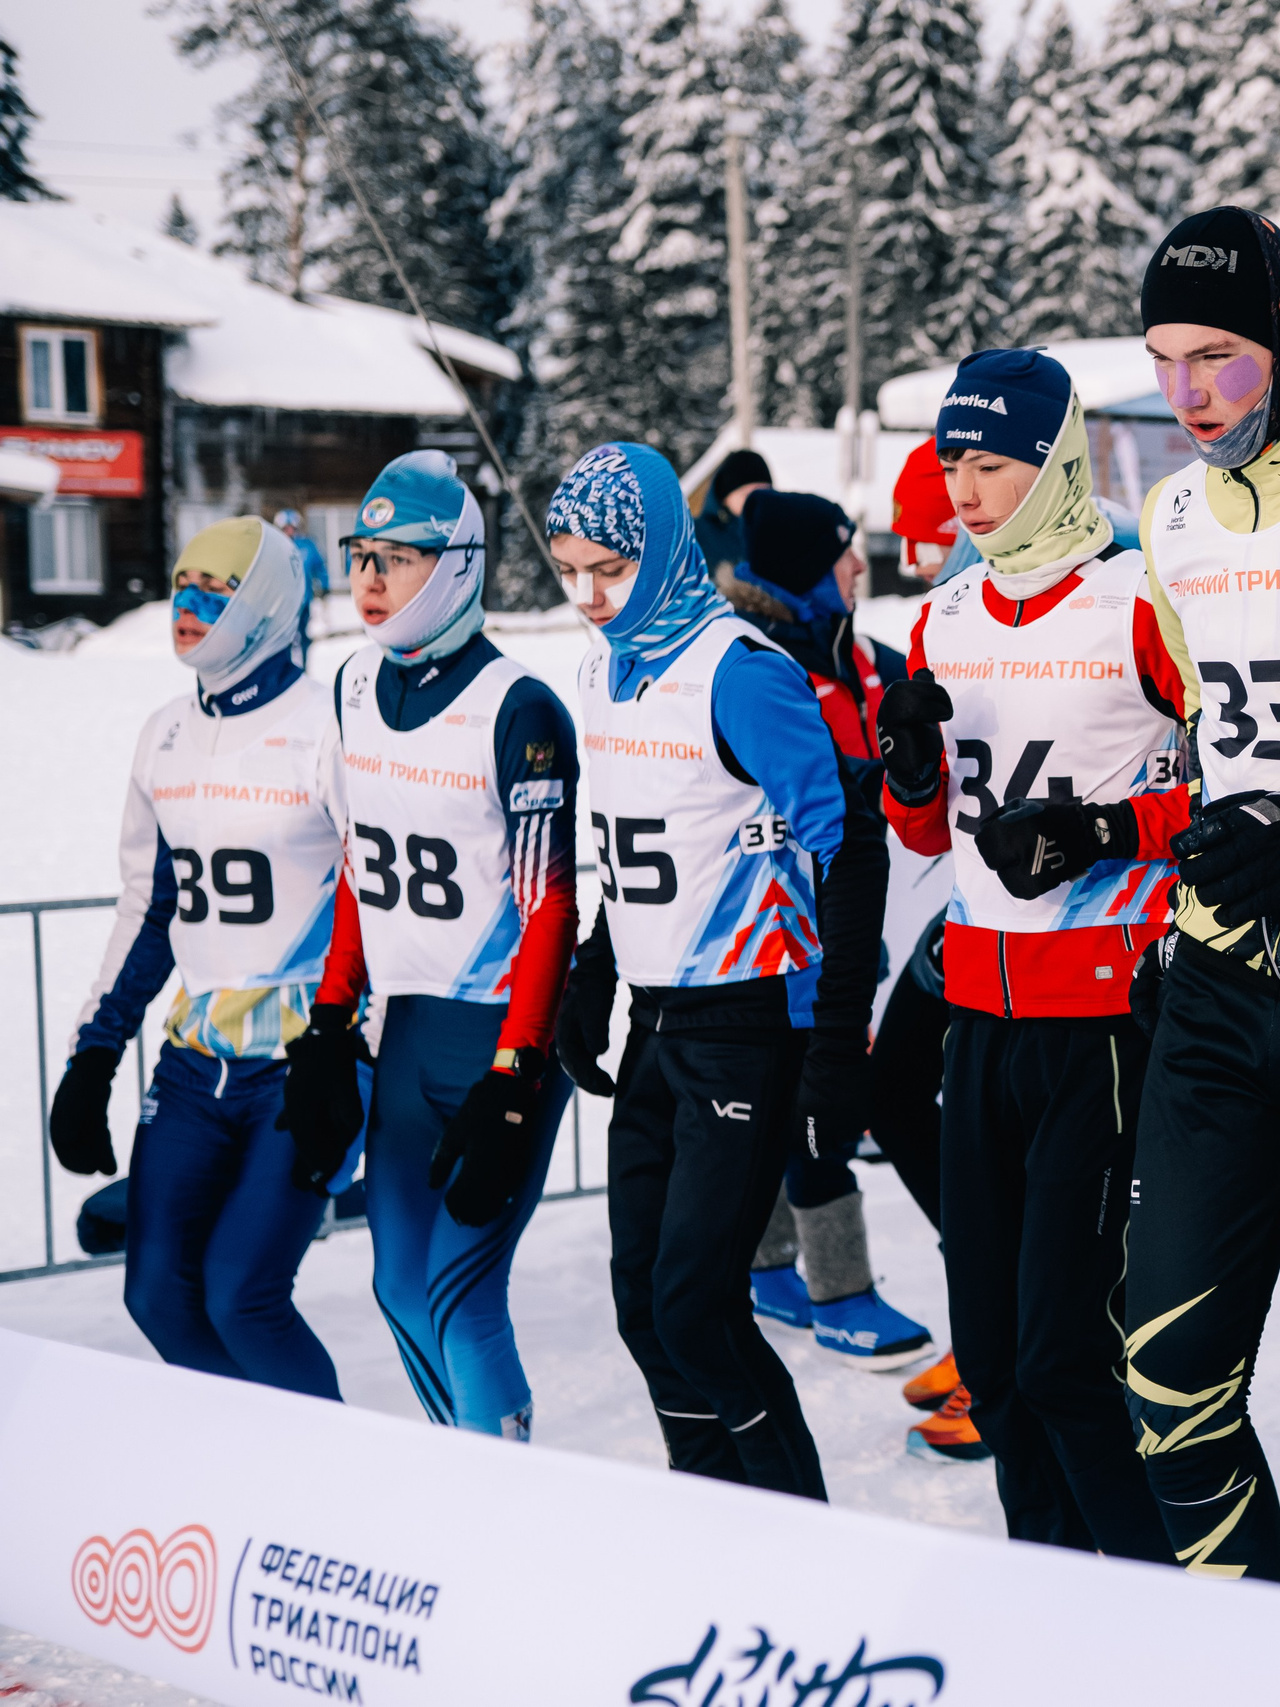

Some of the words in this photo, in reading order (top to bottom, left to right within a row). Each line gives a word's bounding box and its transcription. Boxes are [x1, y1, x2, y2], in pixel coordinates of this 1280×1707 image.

[1000, 659, 1123, 680] ТРИАТЛОН
[607, 737, 703, 761] ТРИАТЛОН
[1155, 756, 1181, 784] 34
[202, 783, 310, 806] ТРИАТЛОН
[389, 760, 488, 791] ТРИАТЛОН
[955, 738, 1083, 836] 34
[745, 819, 787, 847] 35
[354, 821, 465, 921] 38
[591, 811, 678, 905] 35
[173, 847, 274, 925] 39
[711, 1099, 752, 1121] VC
[259, 1542, 440, 1620] ФЕДЕРАЦИЯ
[251, 1592, 422, 1674] ТРИАТЛОНА
[250, 1643, 364, 1706] РОССИИ
